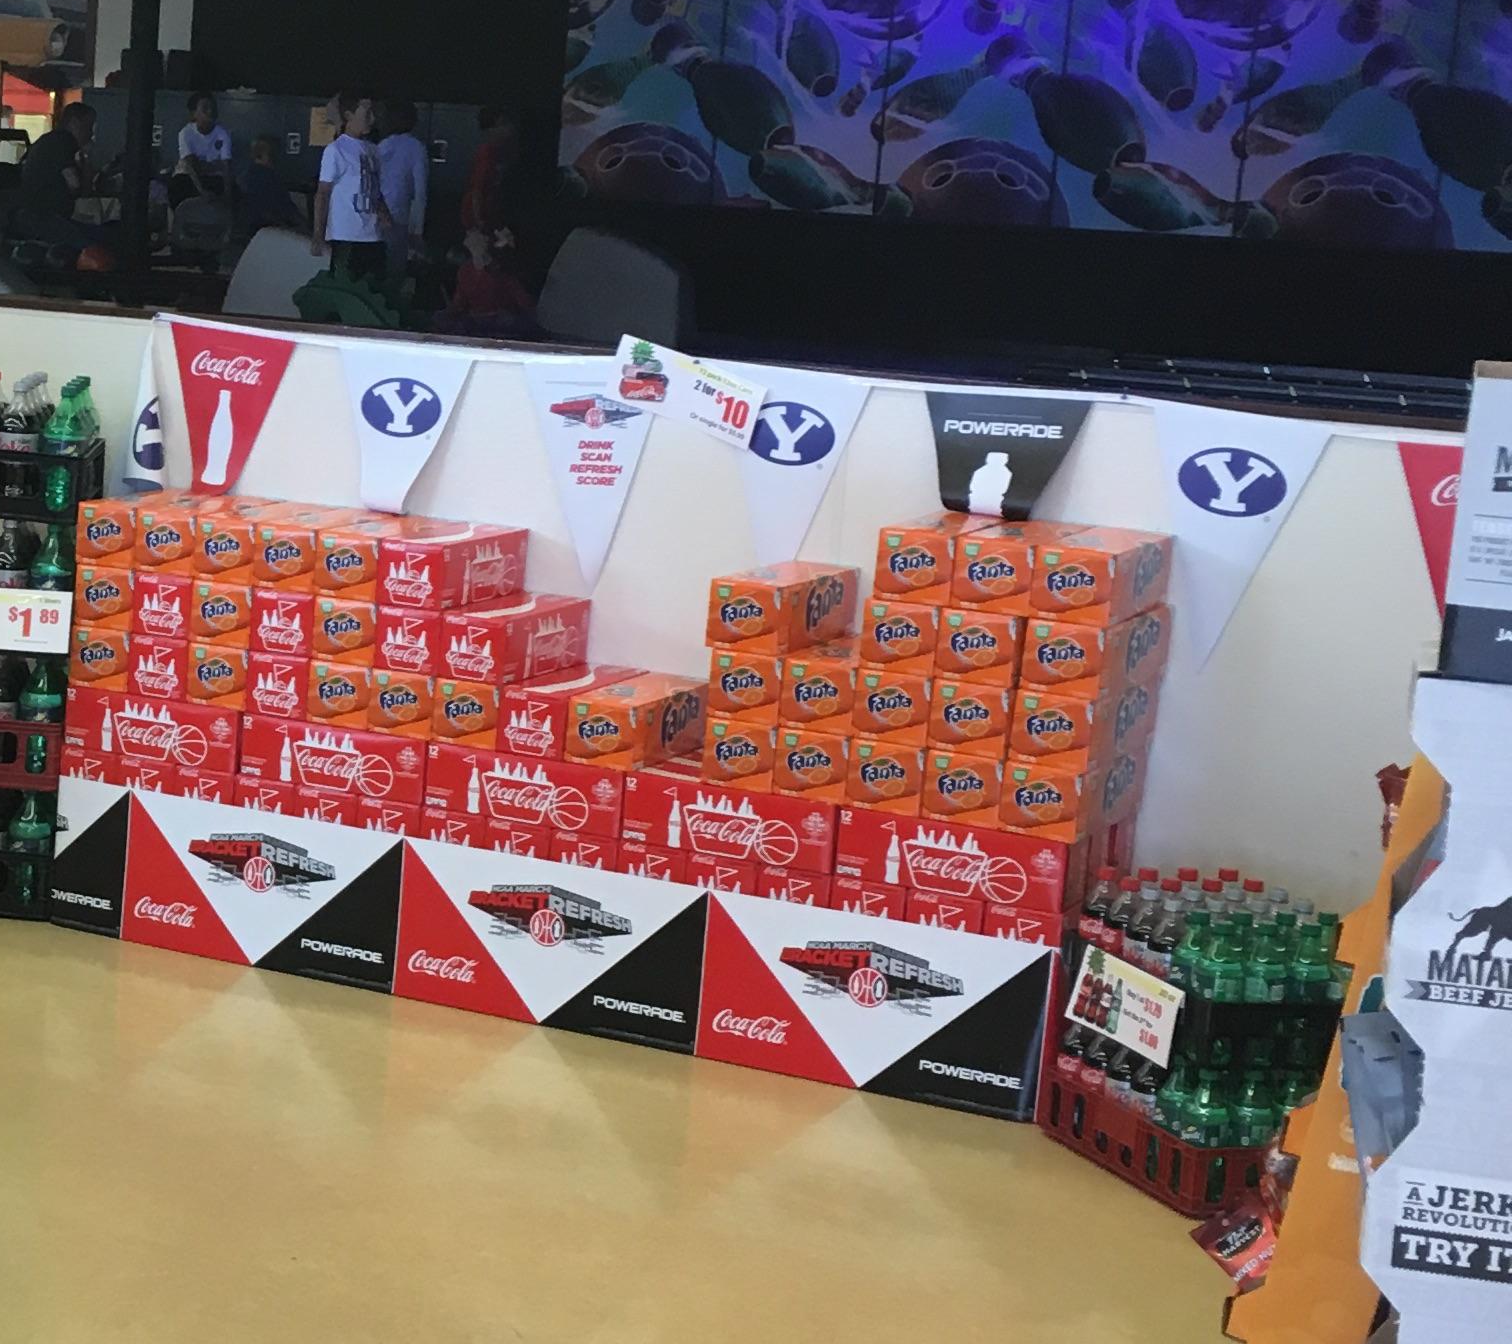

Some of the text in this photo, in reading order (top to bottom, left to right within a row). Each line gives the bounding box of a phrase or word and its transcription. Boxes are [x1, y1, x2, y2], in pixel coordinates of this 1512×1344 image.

[693, 379, 702, 391] 2
[702, 383, 716, 396] for
[715, 391, 749, 429] $10
[943, 419, 1064, 440] POWERADE
[578, 440, 614, 450] DRINK
[580, 452, 612, 462] SCAN
[569, 464, 622, 475] REFRESH
[576, 476, 616, 487] SCORE
[87, 523, 122, 542] Fanta
[145, 528, 181, 548] Fanta
[205, 536, 240, 556] Fanta
[264, 544, 300, 563] Fanta
[326, 552, 362, 573] Fanta
[890, 551, 935, 574] Fanta
[968, 561, 1015, 582] Fanta
[1047, 570, 1095, 592] Fanta
[40, 609, 59, 624] 89
[721, 603, 763, 622] Fanta
[875, 621, 920, 643] Fanta
[951, 631, 996, 653] Fanta
[1037, 642, 1085, 664] Fanta
[721, 672, 763, 692] Fanta
[795, 682, 838, 703] Fanta
[868, 691, 912, 713] Fanta
[944, 702, 990, 724] Fanta
[578, 719, 619, 739] Fanta
[1026, 714, 1074, 737] Fanta
[716, 741, 759, 761] Fanta
[788, 751, 831, 771] Fanta
[860, 762, 905, 783] Fanta
[938, 772, 984, 794] Fanta
[1015, 784, 1062, 806] Fanta
[261, 842, 336, 879] REFRESH
[50, 888, 113, 910] OWERADE
[548, 894, 632, 935] REFRESH
[300, 937, 384, 964] POWERADE
[870, 951, 964, 995] REFRESH
[1428, 949, 1512, 989] MATA
[1429, 985, 1484, 1005] BEEF
[593, 994, 686, 1024] POWERADE
[918, 1059, 1024, 1089] POWERADE
[1406, 1185, 1512, 1217] A JERK
[1402, 1207, 1512, 1234] REVOLUTI
[1400, 1234, 1479, 1268] TRY
